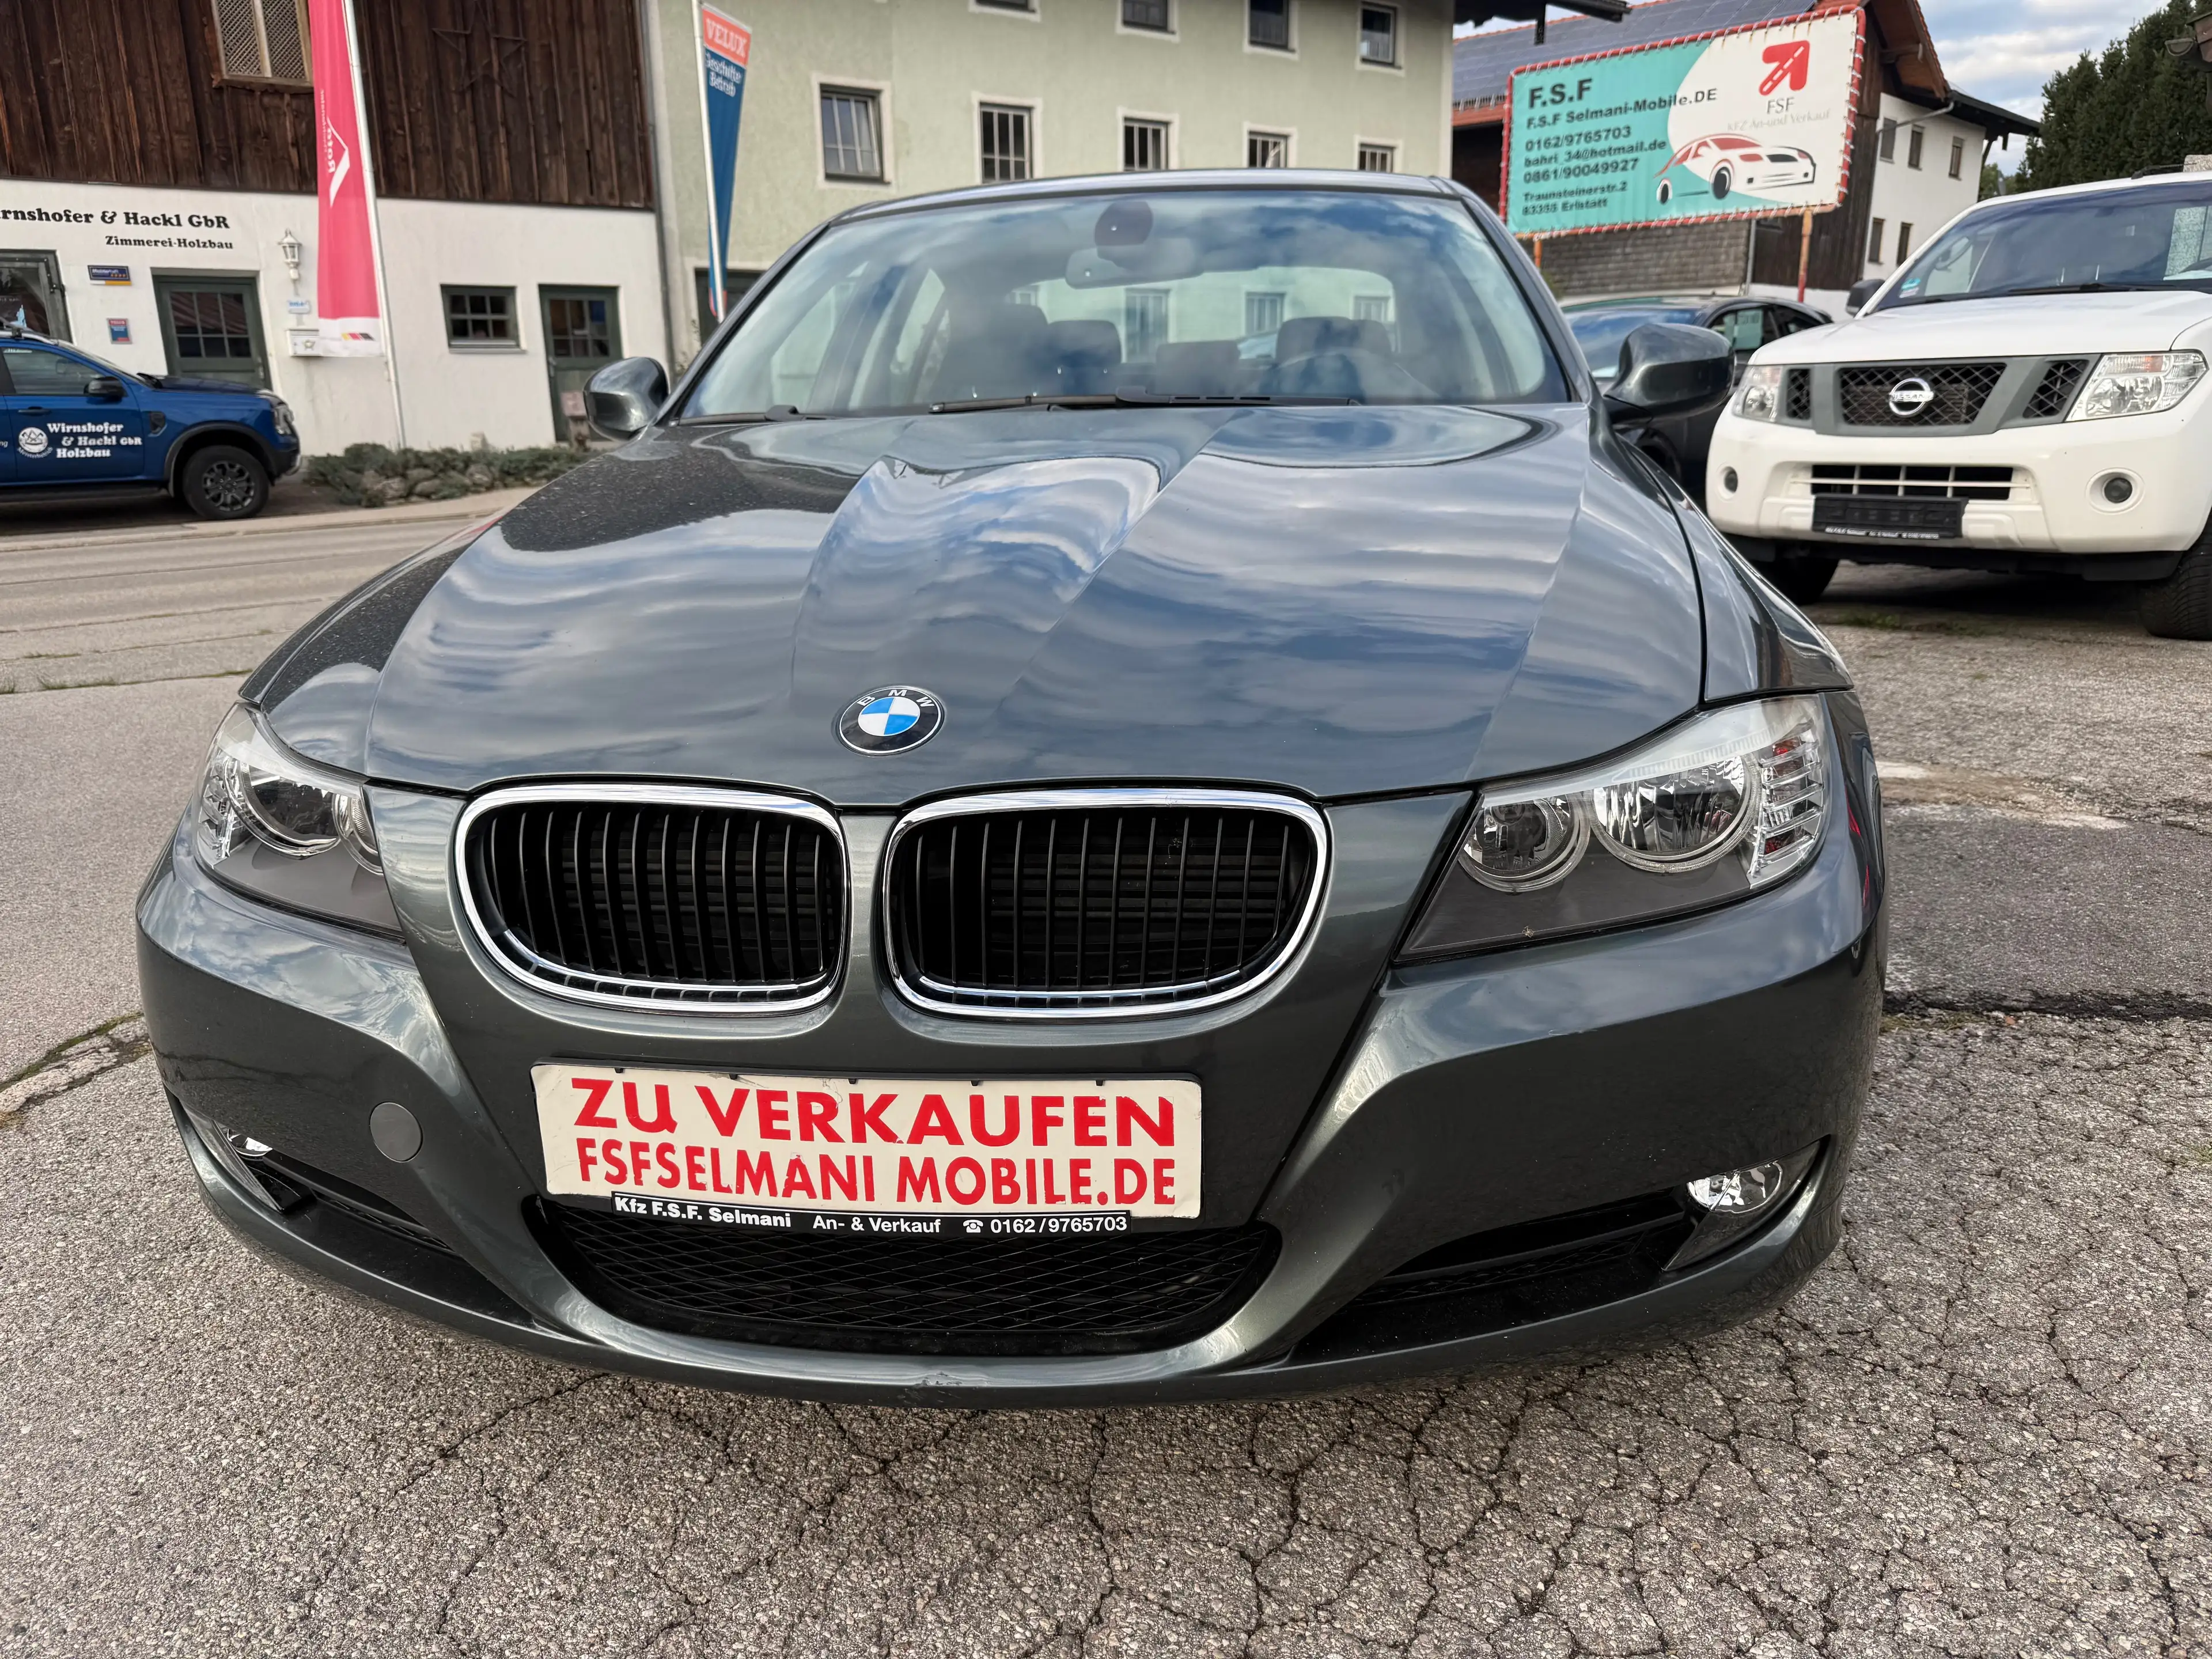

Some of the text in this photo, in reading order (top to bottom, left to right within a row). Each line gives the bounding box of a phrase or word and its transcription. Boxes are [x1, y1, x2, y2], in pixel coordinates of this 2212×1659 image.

[706, 18, 747, 58] VELUX
[1528, 77, 1592, 109] F.S.F
[1766, 97, 1795, 114] FSF
[1526, 88, 1718, 130] F.S.F Selmani-Mobile.DE
[1525, 125, 1631, 152] 0162/9765703
[1523, 157, 1639, 184] 0861/90049927
[100, 211, 117, 224] &
[123, 211, 183, 227] Hackl
[188, 214, 230, 229] GbR
[47, 422, 124, 434] Wirnshofer
[61, 435, 143, 446] & Hackl GbR
[56, 448, 111, 458] Holzbau
[857, 689, 935, 707] BMW
[571, 1077, 1175, 1146] ZU VERKAUFEN
[576, 1138, 1175, 1206] FSFSELMANI MOBILE.DE
[615, 1197, 647, 1215] Kfz
[652, 1203, 703, 1221] F.S.F.
[709, 1207, 791, 1227] Selmani
[813, 1215, 845, 1230] An-
[851, 1217, 865, 1231] &
[868, 1217, 941, 1233] Verkauf
